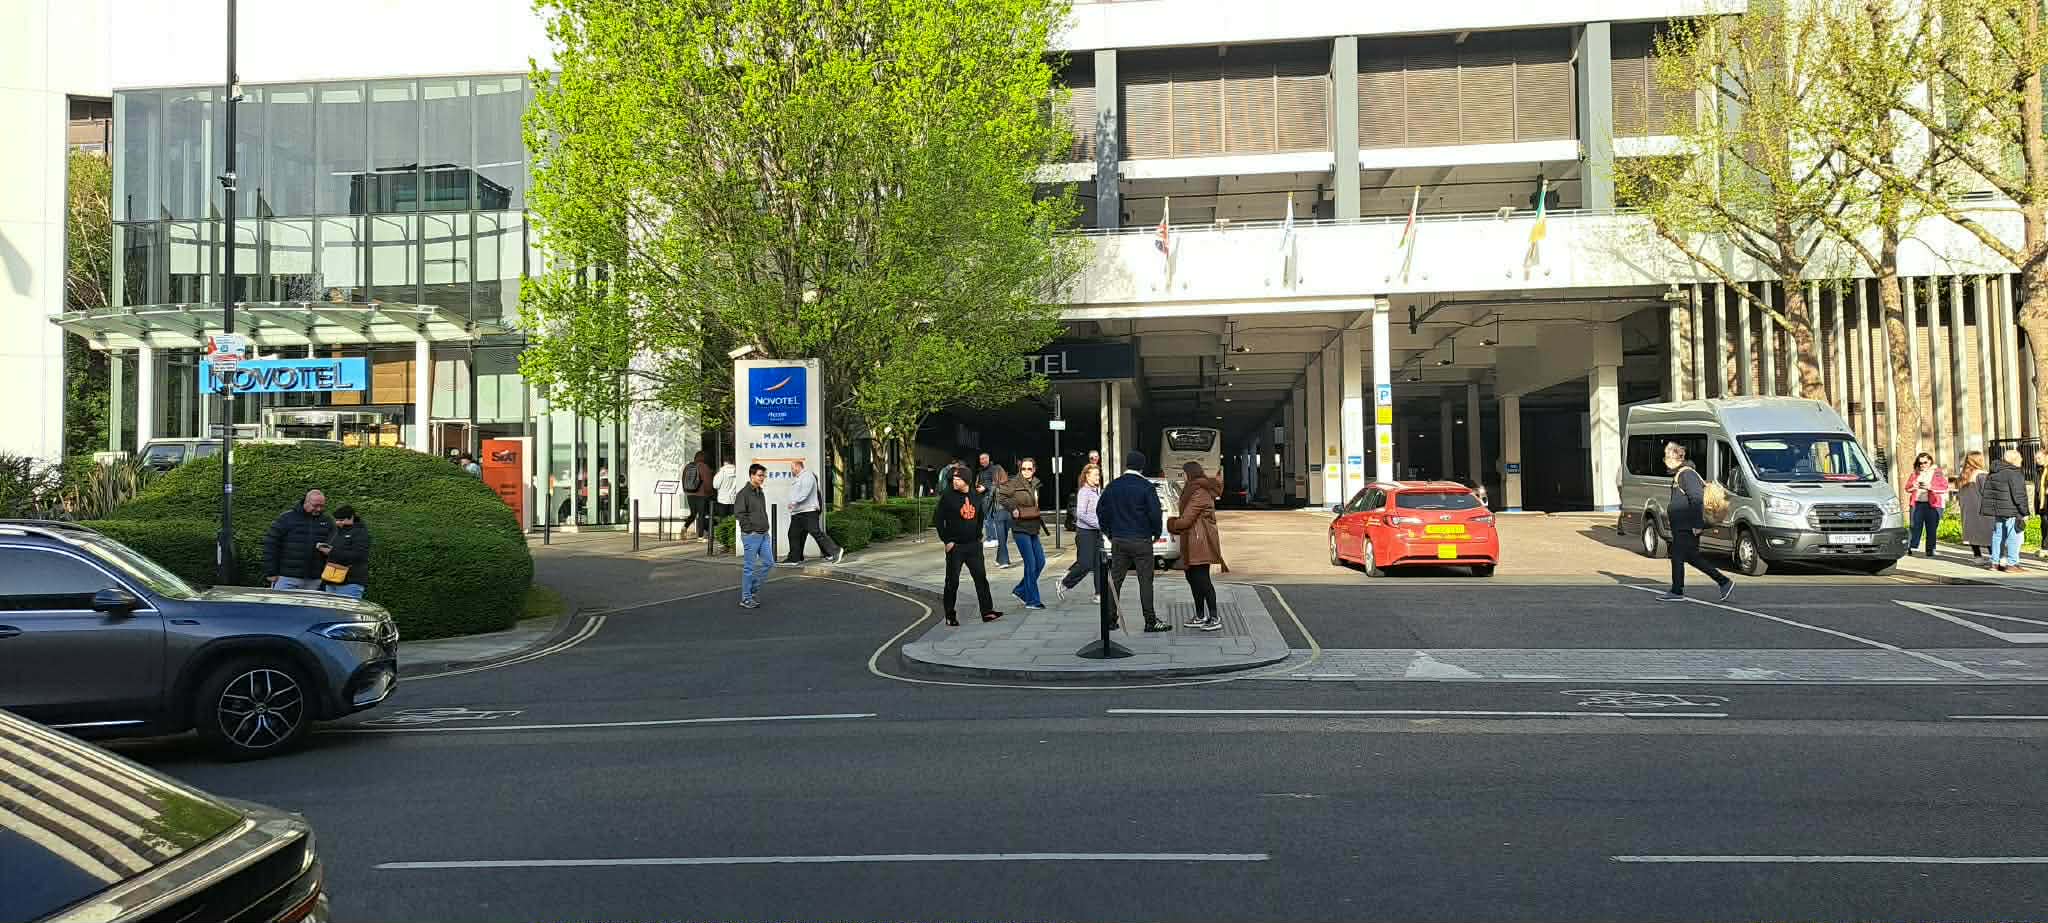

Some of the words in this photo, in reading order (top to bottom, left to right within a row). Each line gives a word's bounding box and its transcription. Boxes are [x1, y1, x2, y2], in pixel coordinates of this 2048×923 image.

[208, 361, 353, 390] NOVOTEL
[755, 396, 800, 405] NOVOTEL
[763, 432, 792, 440] MAIN
